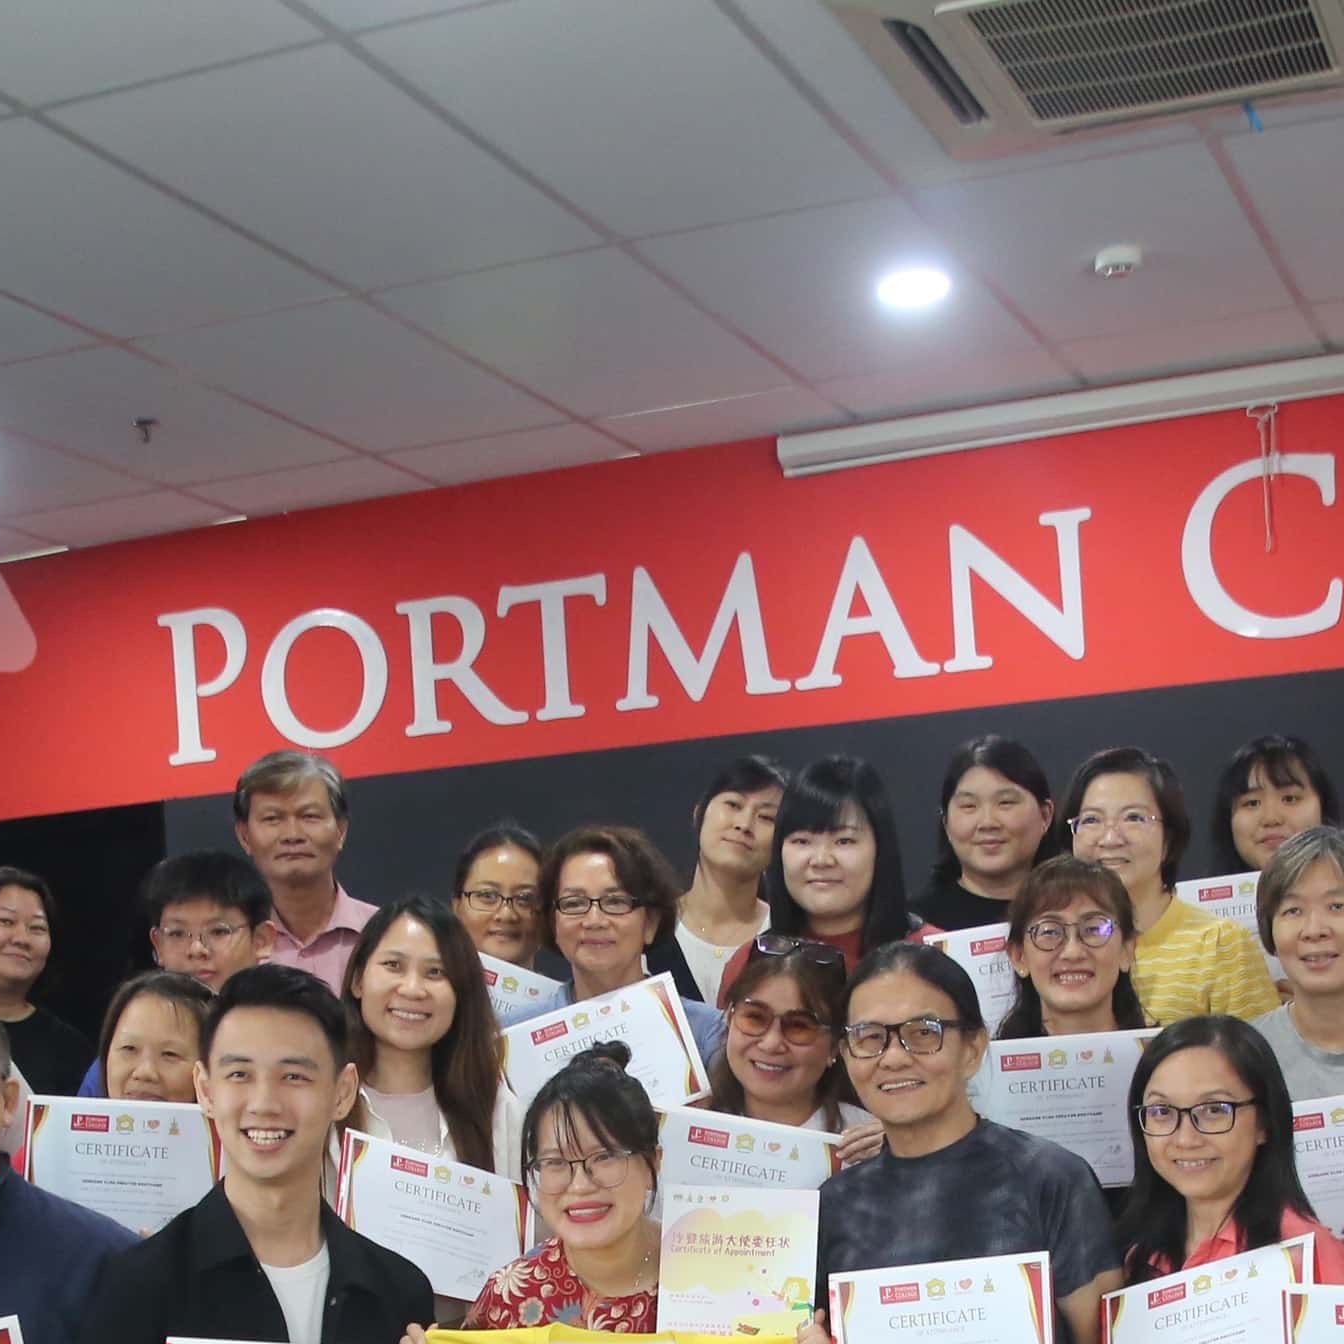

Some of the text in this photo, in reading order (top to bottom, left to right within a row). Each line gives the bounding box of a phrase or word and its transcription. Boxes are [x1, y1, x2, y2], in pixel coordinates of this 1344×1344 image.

[157, 507, 1091, 767] PORTMAN
[1008, 1075, 1106, 1095] CERTIFICATE
[75, 1142, 170, 1160] CERTIFICATE
[690, 1154, 787, 1183] CERTIFICATE
[394, 1180, 483, 1216] CERTIFICATE
[889, 1306, 987, 1331] CERTIFICATE
[1155, 1291, 1249, 1331] CERTIFICATE
